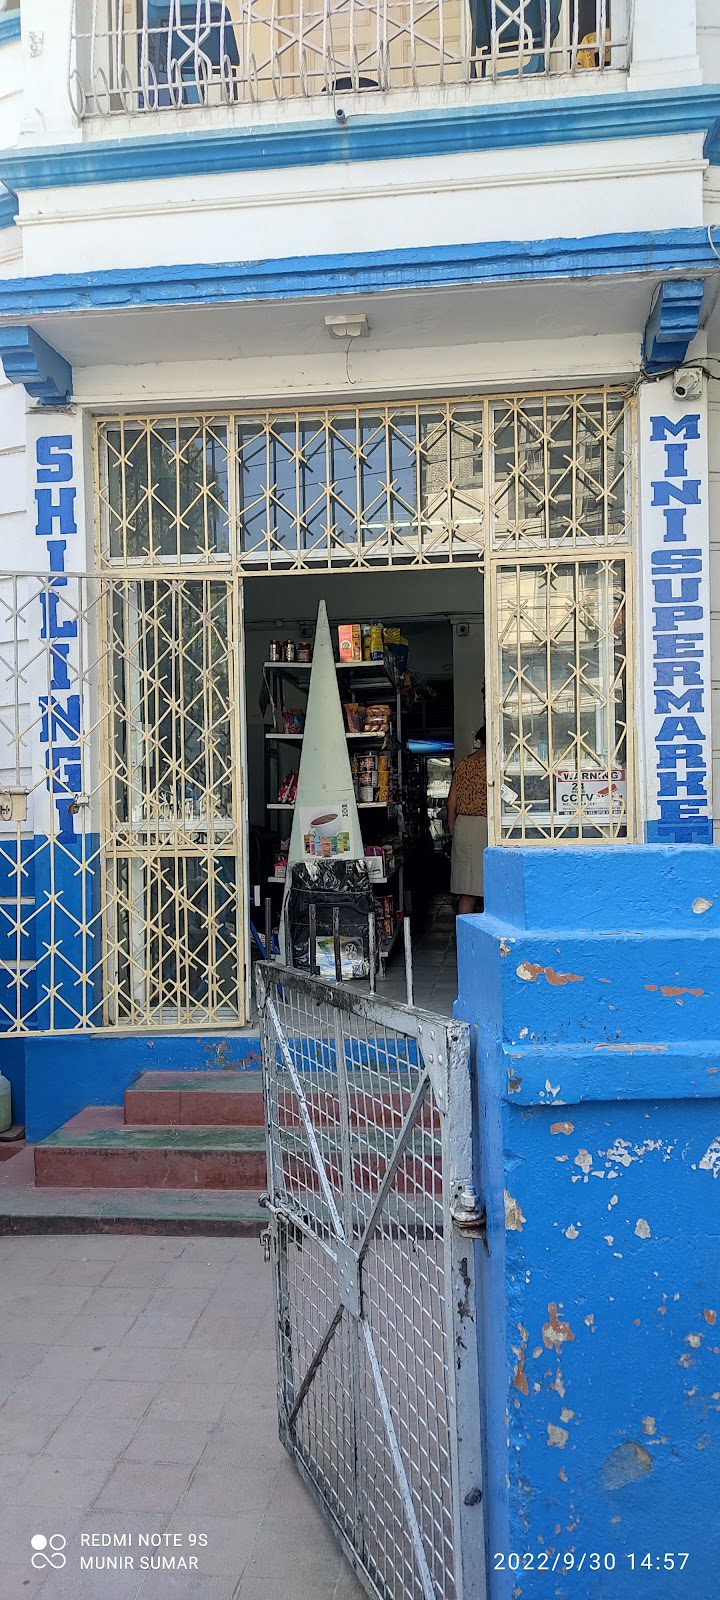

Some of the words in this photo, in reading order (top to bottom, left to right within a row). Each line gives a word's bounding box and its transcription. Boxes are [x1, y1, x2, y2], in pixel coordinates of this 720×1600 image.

[650, 414, 701, 542] MINI
[36, 435, 82, 844] SHILINGI
[651, 549, 708, 843] SUPERMARKET
[561, 794, 594, 802] CCTV
